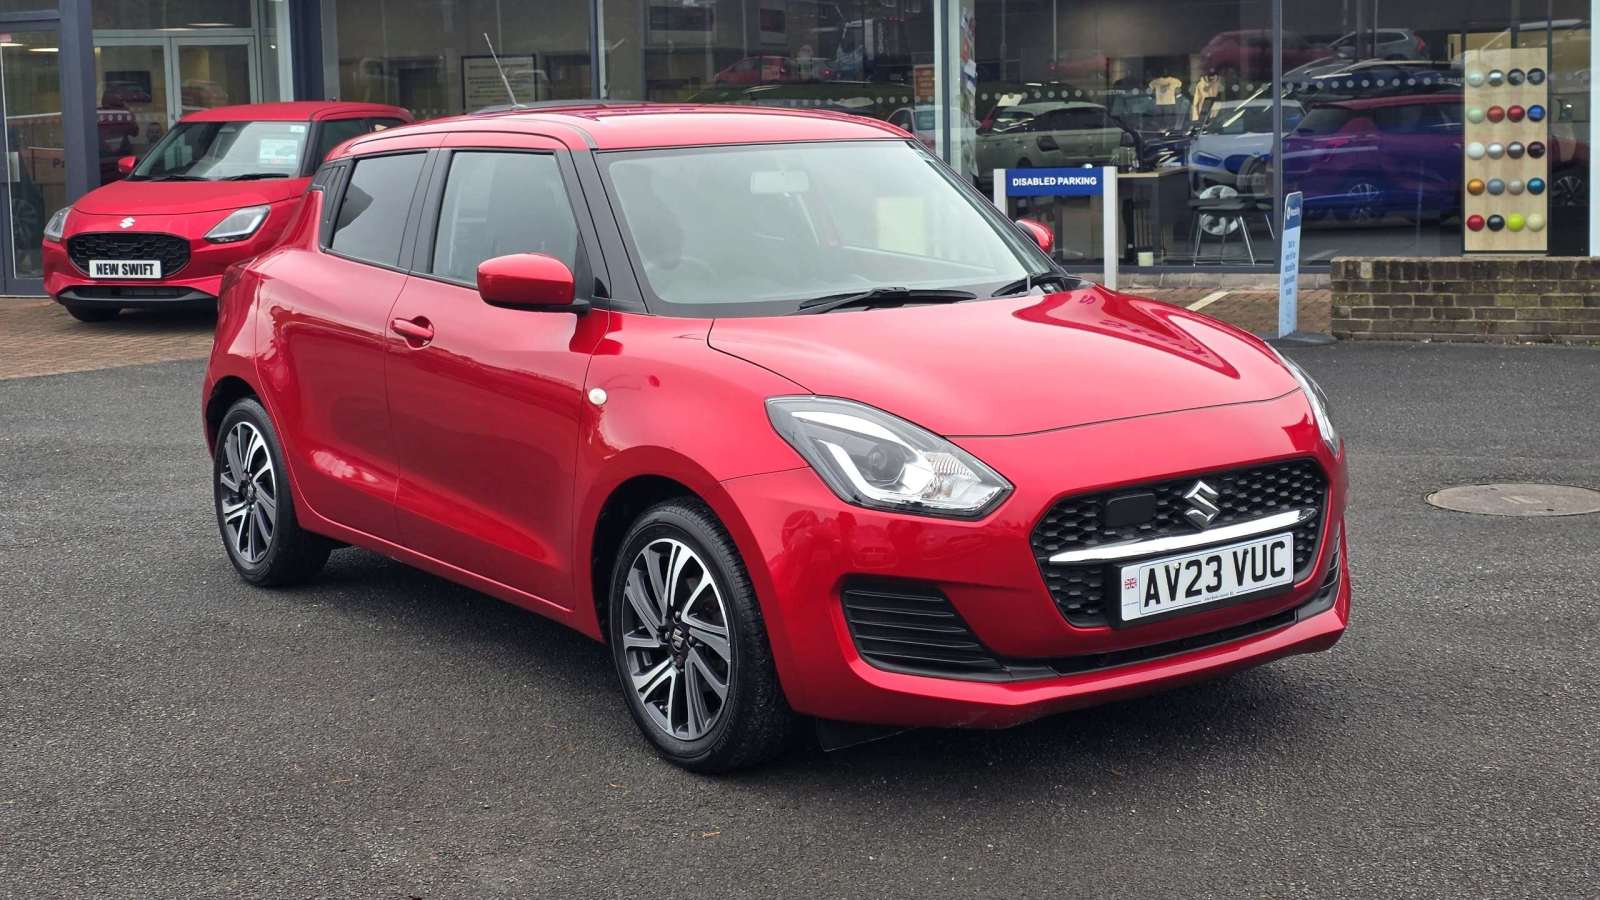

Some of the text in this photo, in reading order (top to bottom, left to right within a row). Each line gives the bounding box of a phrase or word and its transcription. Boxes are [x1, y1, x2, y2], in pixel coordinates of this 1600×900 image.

[1012, 176, 1097, 187] DISABLED PARKING
[96, 263, 154, 275] NEW SWIFT
[1144, 540, 1286, 608] AV23 VUC
